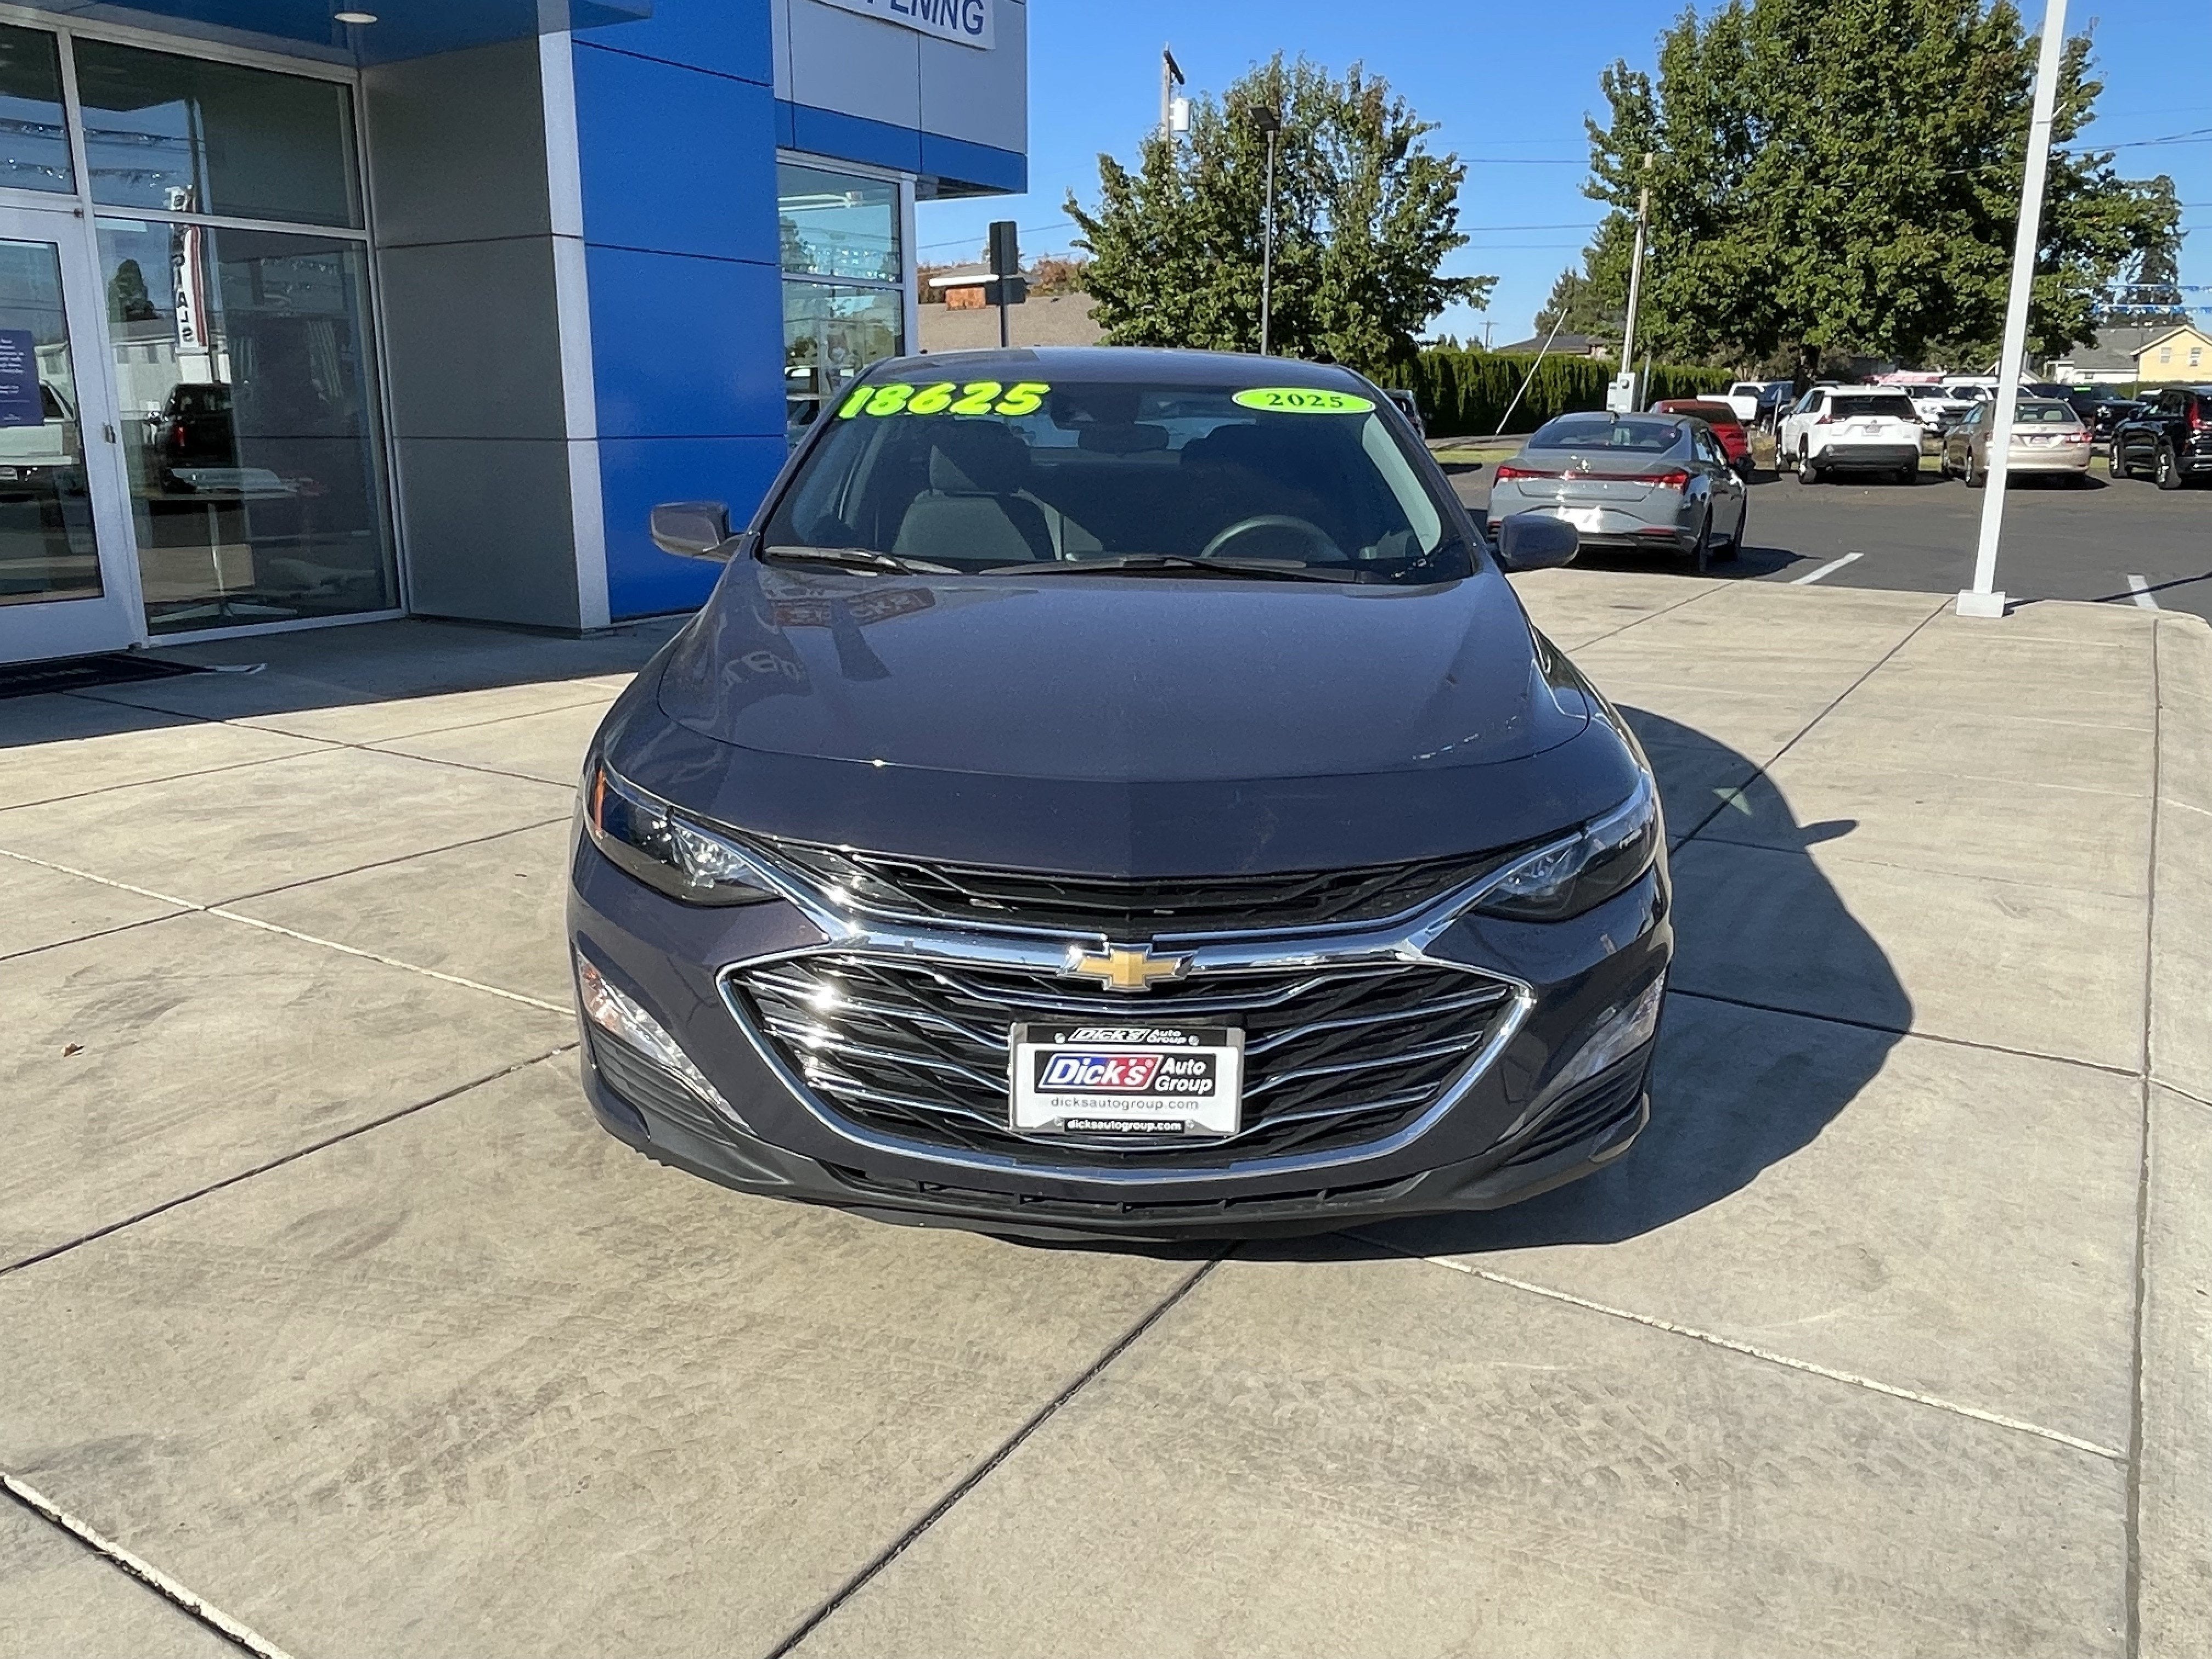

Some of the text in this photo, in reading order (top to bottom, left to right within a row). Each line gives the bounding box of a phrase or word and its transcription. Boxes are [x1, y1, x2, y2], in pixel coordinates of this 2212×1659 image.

[866, 0, 984, 35] NING
[838, 381, 1051, 419] 18625
[1266, 393, 1344, 408] 2025
[1152, 1029, 1182, 1037] Auto
[1160, 1057, 1207, 1075] Auto
[1154, 1075, 1213, 1094] Group
[1051, 1097, 1199, 1110] dicksautogroup.com
[1068, 1119, 1182, 1132] dicksautogroup.com
